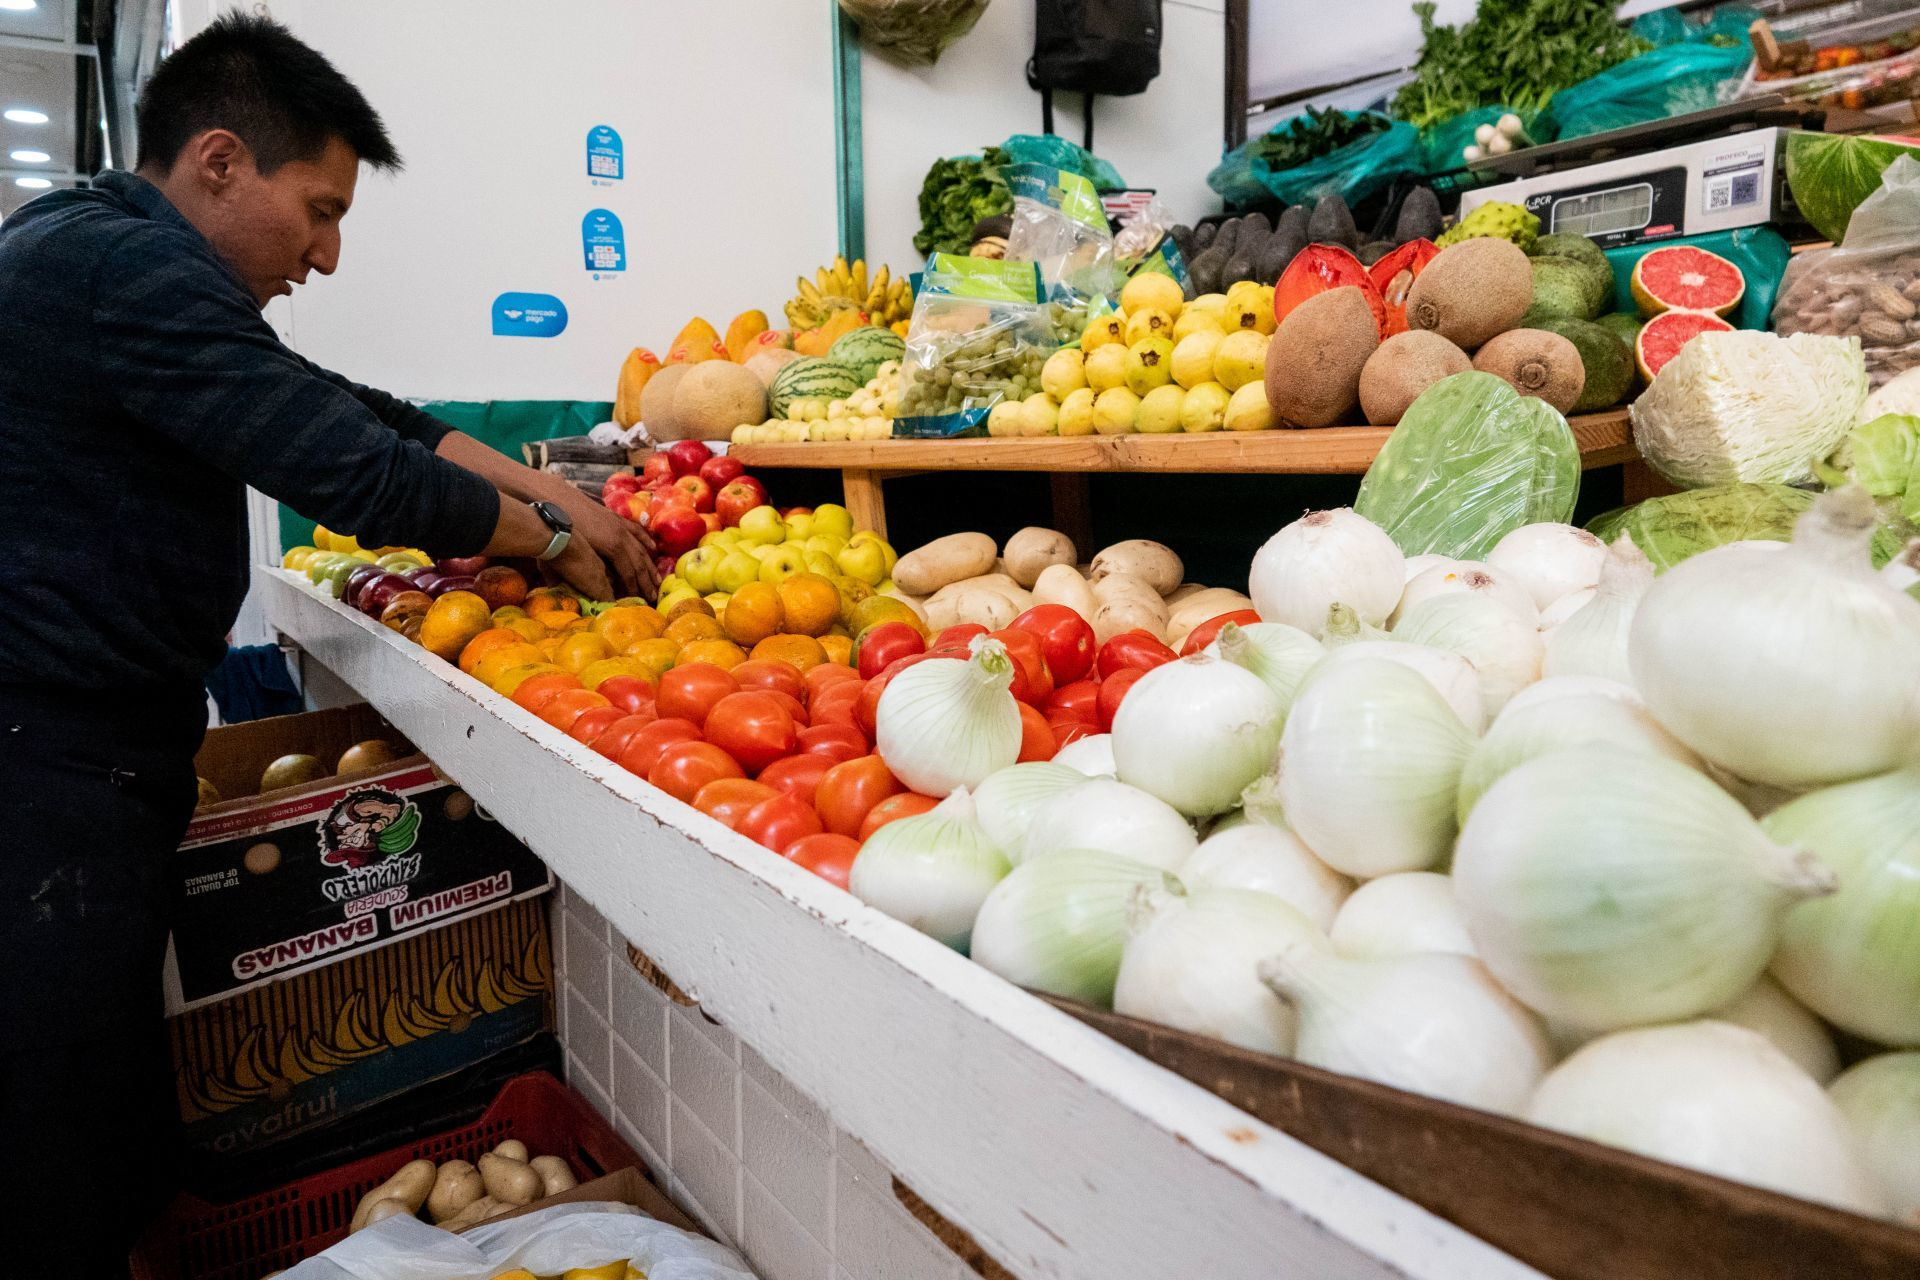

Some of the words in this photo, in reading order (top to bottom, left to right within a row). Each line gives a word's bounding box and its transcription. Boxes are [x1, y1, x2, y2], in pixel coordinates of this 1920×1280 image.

[1526, 194, 1552, 207] L-PCR
[525, 309, 558, 317] mercado
[525, 316, 545, 324] pago
[184, 871, 225, 887] BANANAS
[226, 868, 238, 878] OF
[186, 881, 221, 897] QUALITY
[223, 877, 240, 887] TOP
[347, 887, 406, 915] SCUDERIA
[393, 872, 510, 926] PREMIUM
[237, 915, 375, 974] BANANAS
